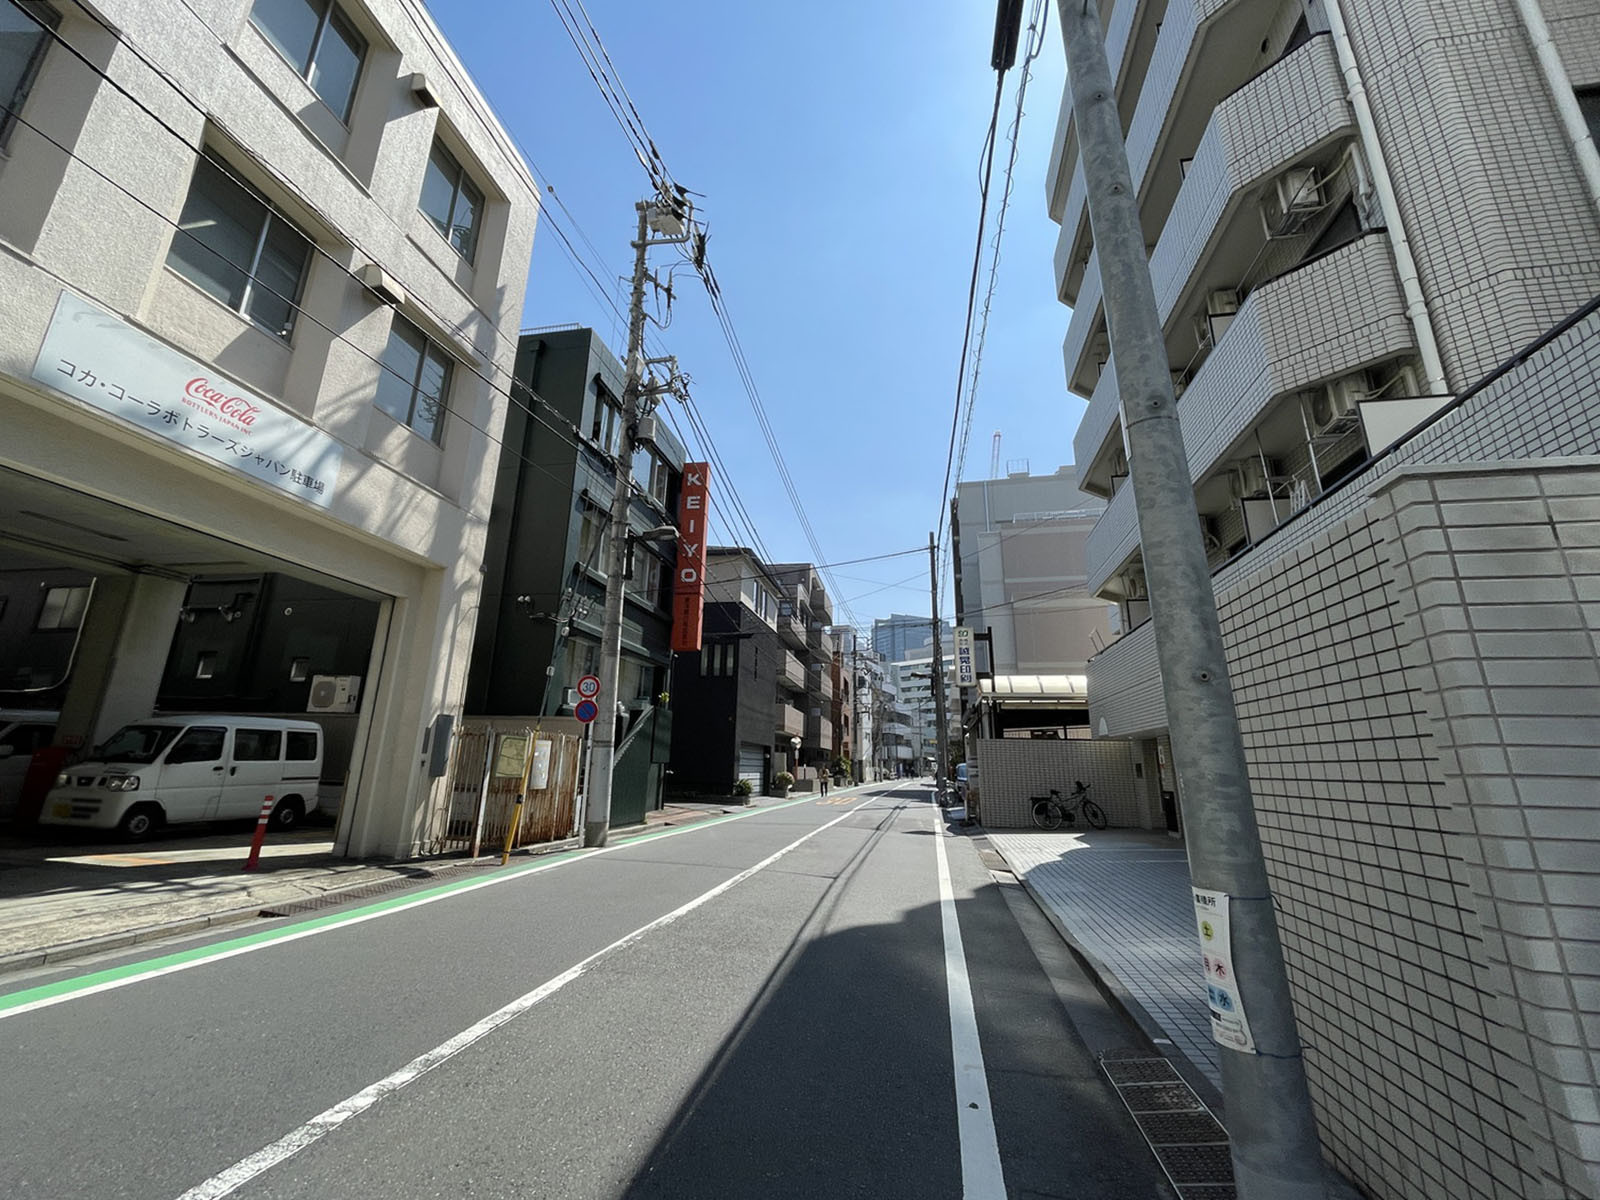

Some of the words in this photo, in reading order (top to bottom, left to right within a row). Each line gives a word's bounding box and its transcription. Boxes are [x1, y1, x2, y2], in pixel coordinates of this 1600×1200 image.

[181, 396, 218, 419] BOTTLERS
[219, 416, 240, 430] JAPAN
[185, 377, 262, 426] Coca-Cola
[57, 357, 326, 496] コカ・コーラボトラーズジャパン駐車場
[680, 473, 702, 583] KEIYO
[582, 681, 596, 693] 30
[1203, 924, 1212, 937] 土
